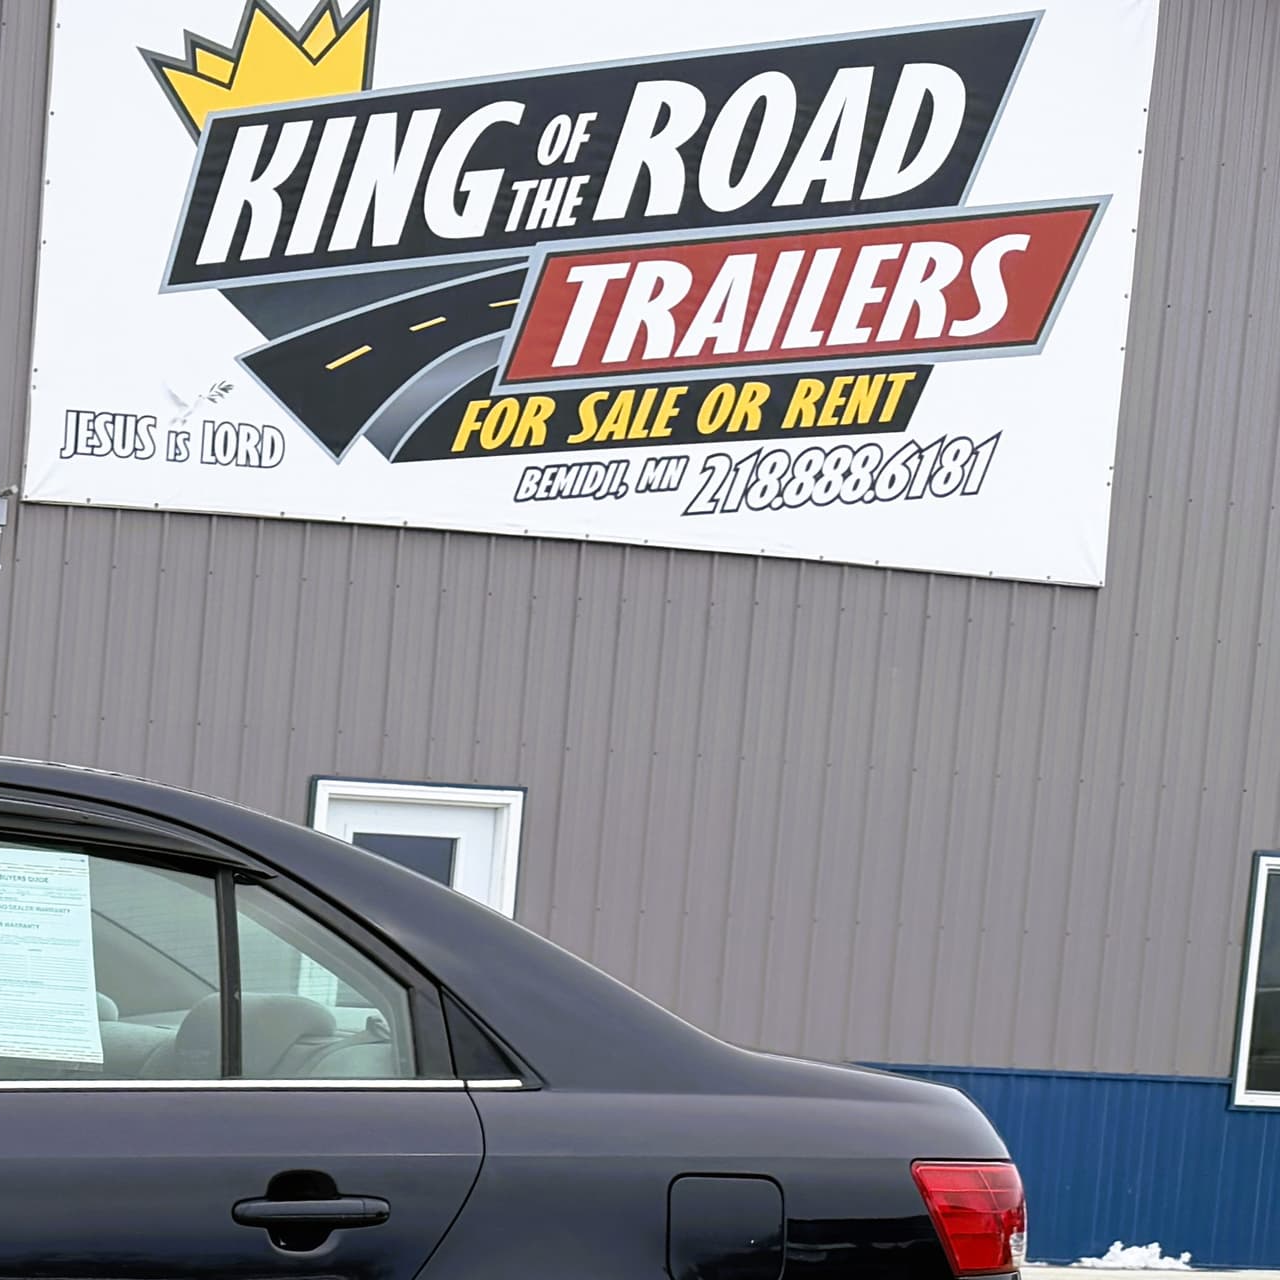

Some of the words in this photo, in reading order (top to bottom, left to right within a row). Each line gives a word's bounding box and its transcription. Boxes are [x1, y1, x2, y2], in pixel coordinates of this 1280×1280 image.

[537, 111, 597, 166] OF
[594, 62, 968, 220] ROAD
[195, 100, 524, 265] KING
[509, 174, 591, 232] THE
[552, 233, 1032, 368] TRAILERS
[61, 409, 157, 460] JESUS
[200, 420, 284, 469] LORD
[451, 396, 555, 452] FOR
[567, 385, 689, 445] SALE
[697, 382, 771, 435] OR
[781, 371, 916, 431] RENT
[514, 458, 629, 502] BEMIDJI,
[636, 455, 690, 493] MN
[681, 430, 1002, 516] 218.888.6181
